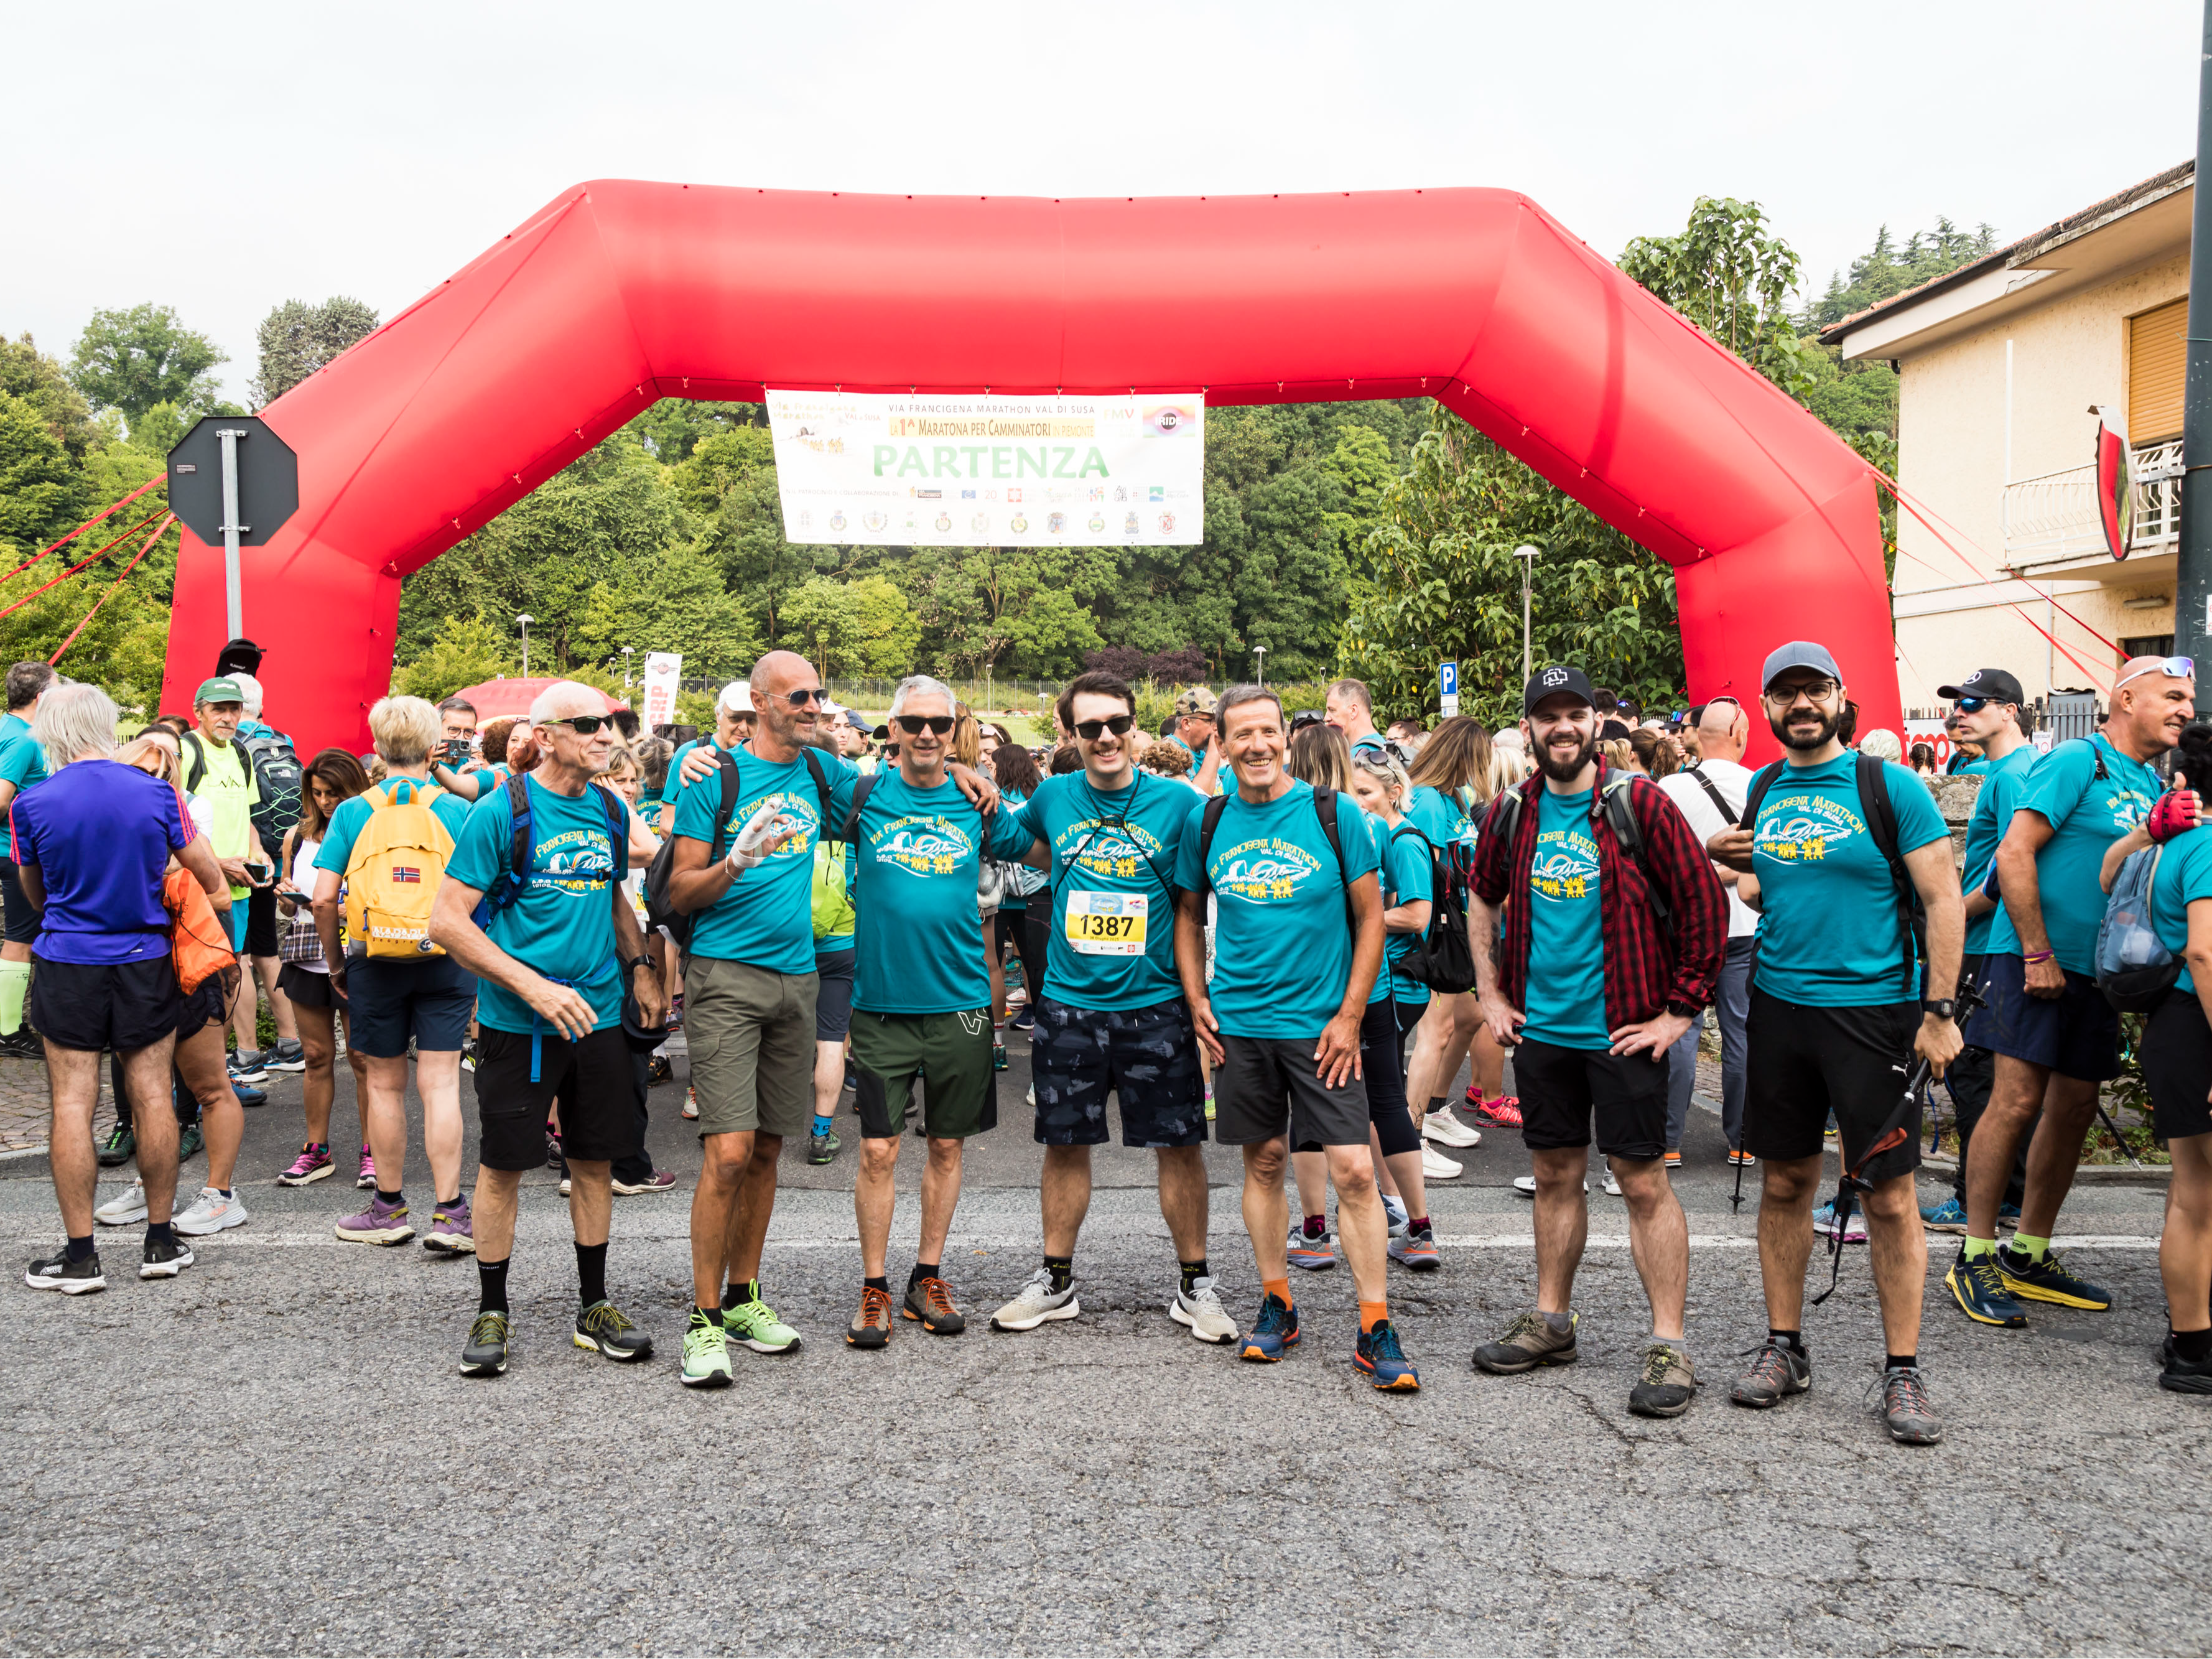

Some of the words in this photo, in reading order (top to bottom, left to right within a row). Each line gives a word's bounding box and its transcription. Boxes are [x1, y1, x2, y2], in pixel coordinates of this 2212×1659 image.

[889, 404, 904, 412] VIA
[909, 404, 972, 413] FRANCIGENA
[977, 405, 1031, 413] MARATHON
[1071, 406, 1095, 414] SUSA
[891, 424, 898, 435] LA
[971, 422, 986, 436] PER
[1053, 425, 1060, 435] IN
[1061, 425, 1094, 437] PIEMONTE
[1155, 416, 1183, 425] IRIDE
[873, 444, 1110, 478] PARTENZA
[985, 490, 997, 500] 20
[1443, 666, 1454, 693] P
[799, 806, 812, 820] SUSA
[1758, 795, 1810, 824] FRANCIGENA
[1811, 795, 1866, 835] MARATHON
[1813, 807, 1822, 816] DI
[1822, 810, 1844, 826] SUSA
[726, 819, 742, 834] VIA
[869, 830, 884, 845] VIA
[883, 816, 934, 834] FRANCIGENA
[936, 814, 974, 853] MARATHON
[535, 830, 584, 858] FRANCIGENA
[590, 841, 598, 849] DI
[1056, 832, 1067, 848] VIA
[1122, 820, 1163, 853] ARATHON
[1537, 830, 1566, 844] CIGENA
[1568, 831, 1600, 857] MARAT
[1209, 863, 1220, 880] VIA
[1219, 839, 1269, 866] FRANCIGENA
[1271, 837, 1322, 871] MARATHON
[1275, 850, 1283, 858] DI
[1283, 853, 1303, 867] SUSA
[1556, 840, 1569, 849] VAL
[1569, 843, 1578, 852] DI
[1578, 847, 1598, 865] SUSA
[1080, 914, 1133, 937] 1387
[208, 1204, 228, 1219] HOKA
[1287, 1240, 1301, 1248] OKA
